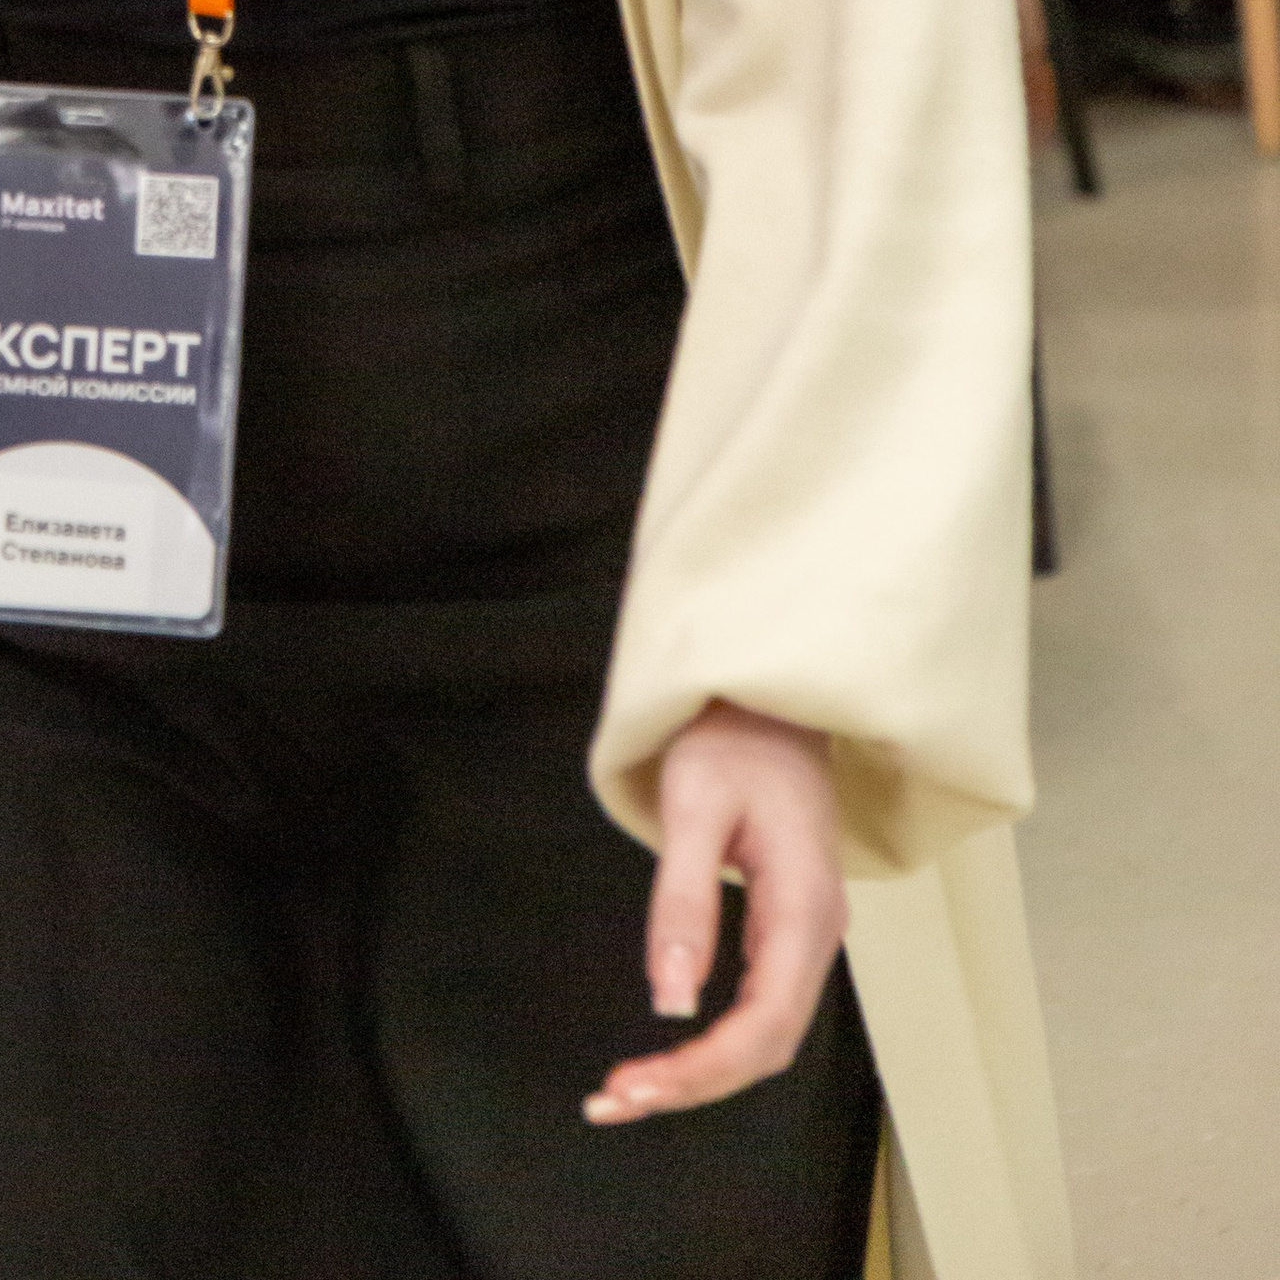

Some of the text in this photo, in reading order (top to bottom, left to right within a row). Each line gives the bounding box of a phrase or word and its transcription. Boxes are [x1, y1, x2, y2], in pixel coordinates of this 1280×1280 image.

[0, 191, 105, 221] Maxitet
[72, 378, 197, 406] КОМИССИИ
[5, 512, 126, 542] Елизавета
[1, 541, 125, 570] Степанова
